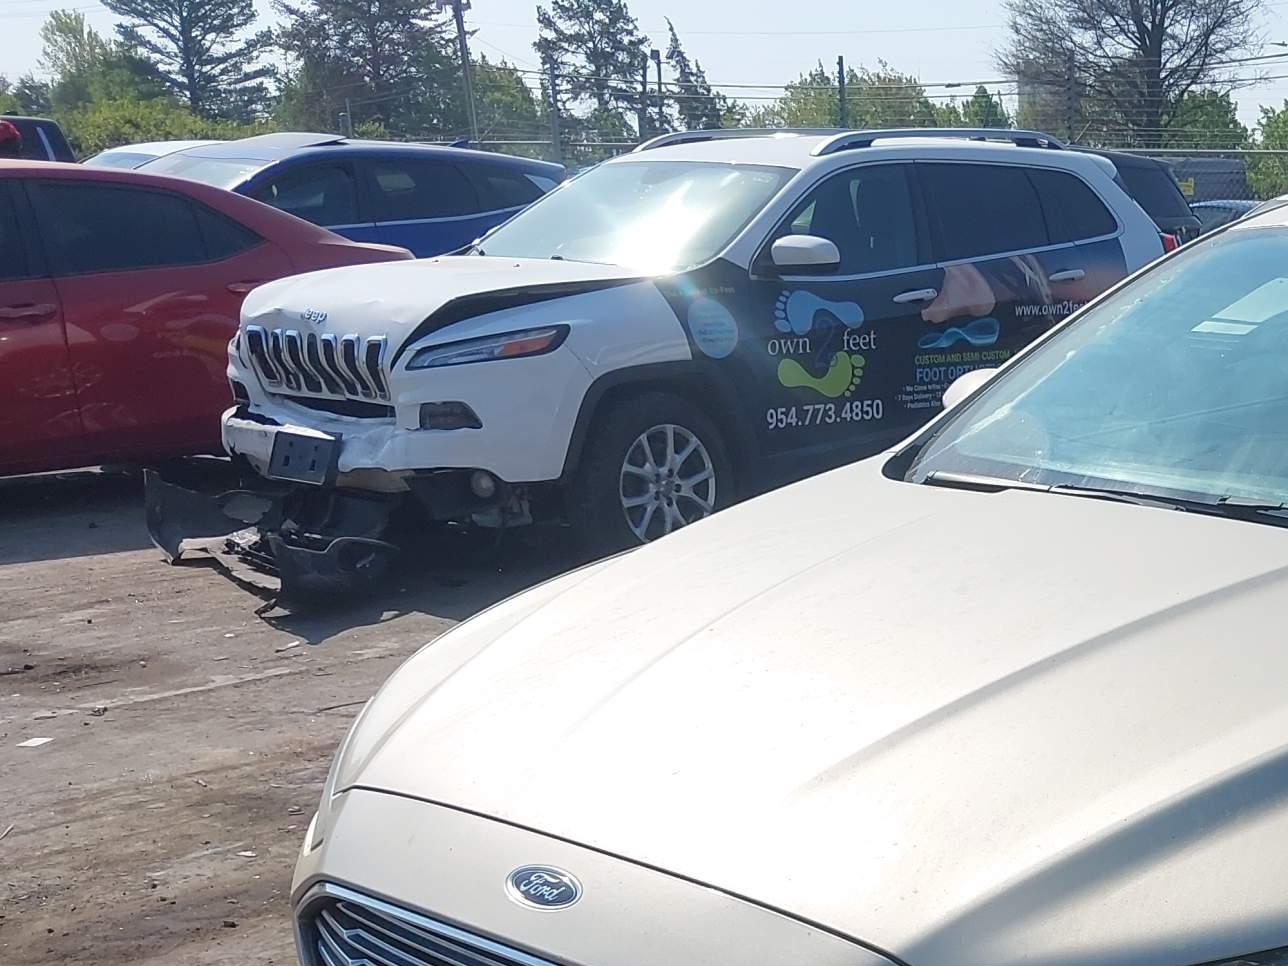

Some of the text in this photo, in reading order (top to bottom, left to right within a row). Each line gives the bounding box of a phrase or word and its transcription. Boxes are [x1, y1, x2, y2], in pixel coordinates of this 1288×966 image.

[1015, 300, 1087, 317] www.own2fe
[767, 337, 811, 356] own
[843, 328, 877, 351] feet
[914, 350, 1010, 365] CUSTOM AND SEMI CUSTOM
[916, 366, 947, 382] FOOT
[766, 400, 883, 430] 954.773.4850
[520, 872, 566, 901] Ford
